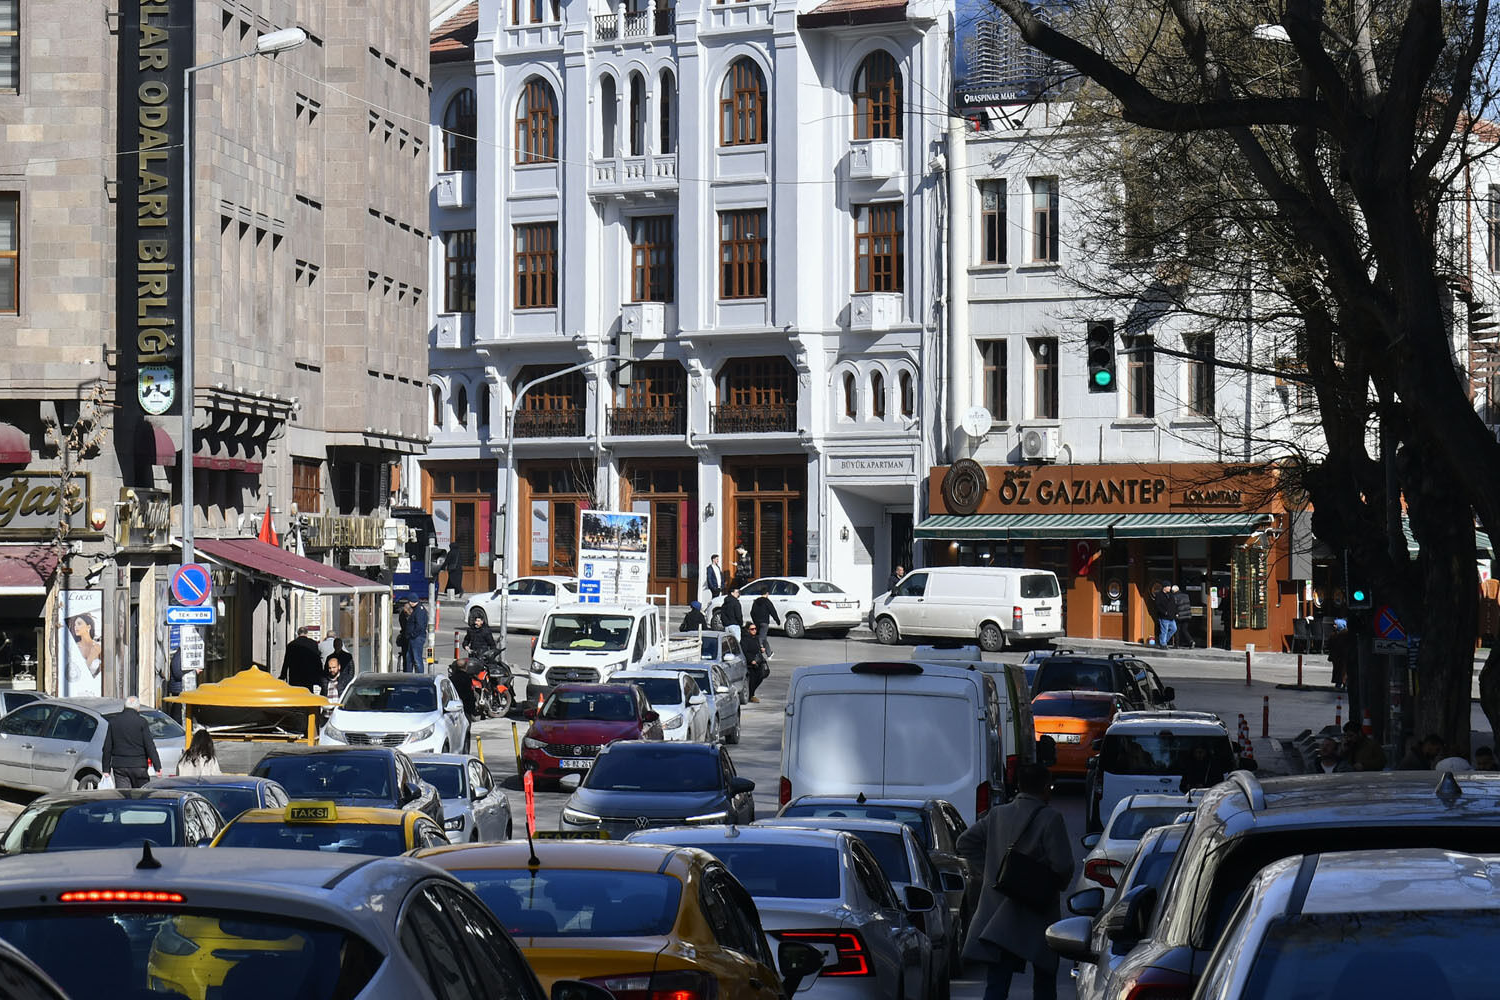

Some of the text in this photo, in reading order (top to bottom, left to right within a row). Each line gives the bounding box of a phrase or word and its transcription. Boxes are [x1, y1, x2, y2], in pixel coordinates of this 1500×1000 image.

[969, 92, 1017, 103] BAŞPINAR MAH.
[138, 80, 169, 228] ODALARI
[137, 239, 176, 363] BİRLİĞİ
[841, 460, 904, 469] BÜYÜK APARTMAN
[999, 476, 1031, 505] ÖZ
[292, 808, 328, 818] TAKSİ
